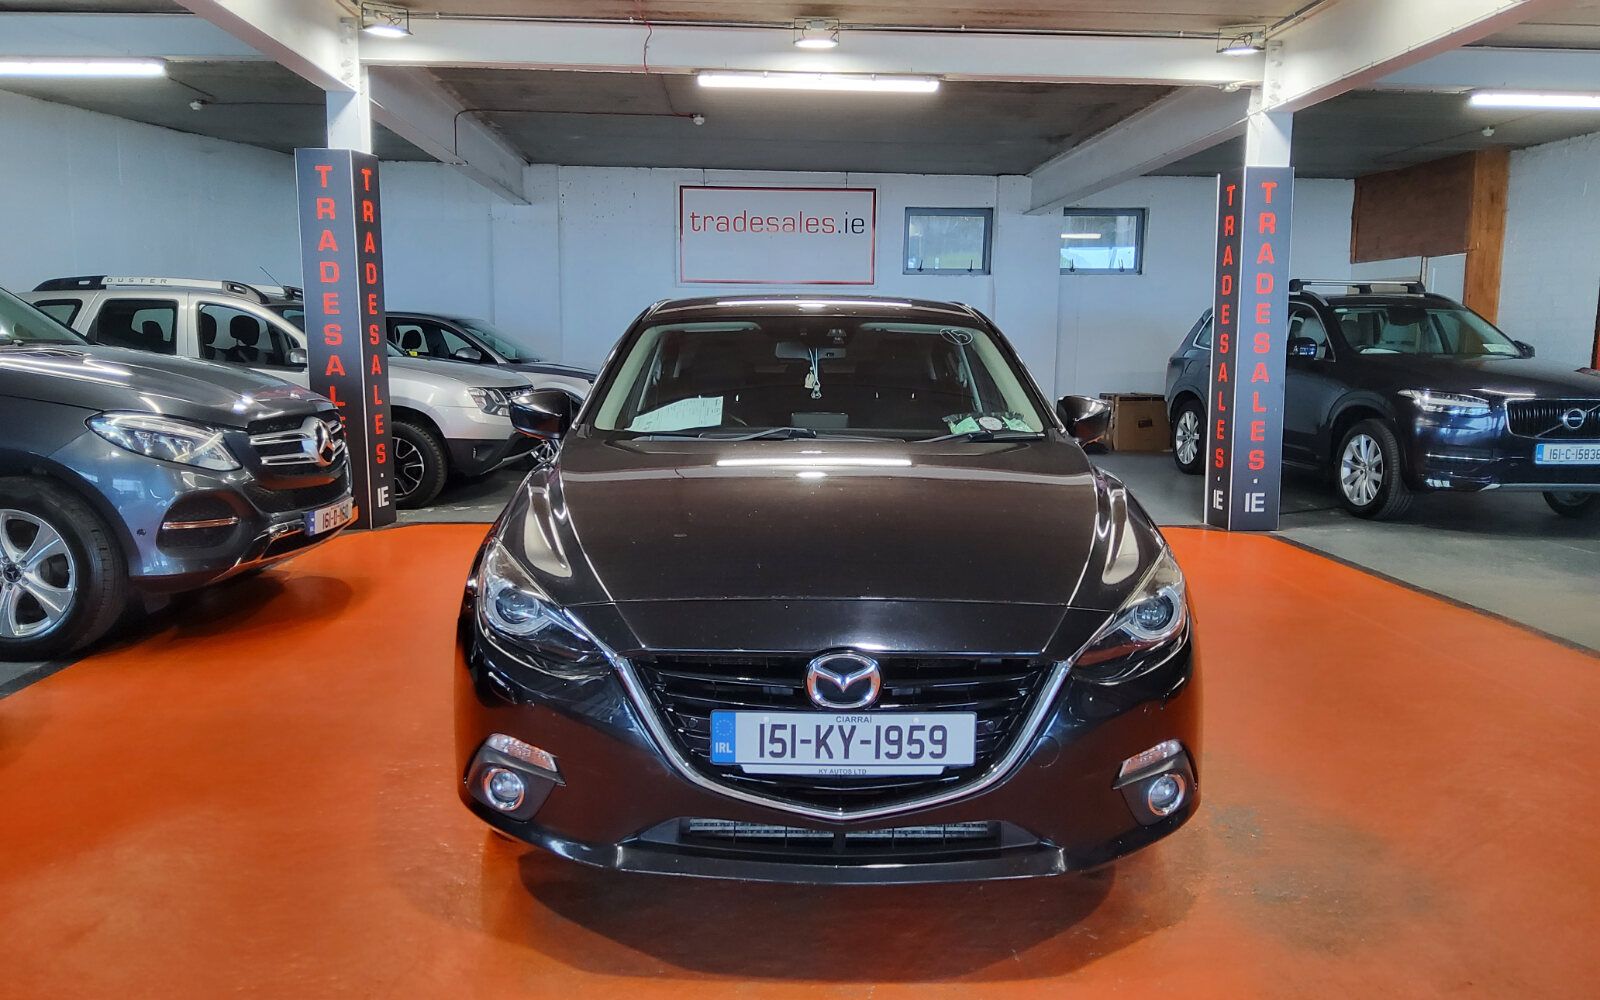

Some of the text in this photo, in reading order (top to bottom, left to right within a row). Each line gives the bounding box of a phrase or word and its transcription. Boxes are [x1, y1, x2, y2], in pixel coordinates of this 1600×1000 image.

[689, 209, 865, 234] tradesales.ie
[715, 742, 733, 753] IRL
[758, 723, 948, 760] 151-KY-1959
